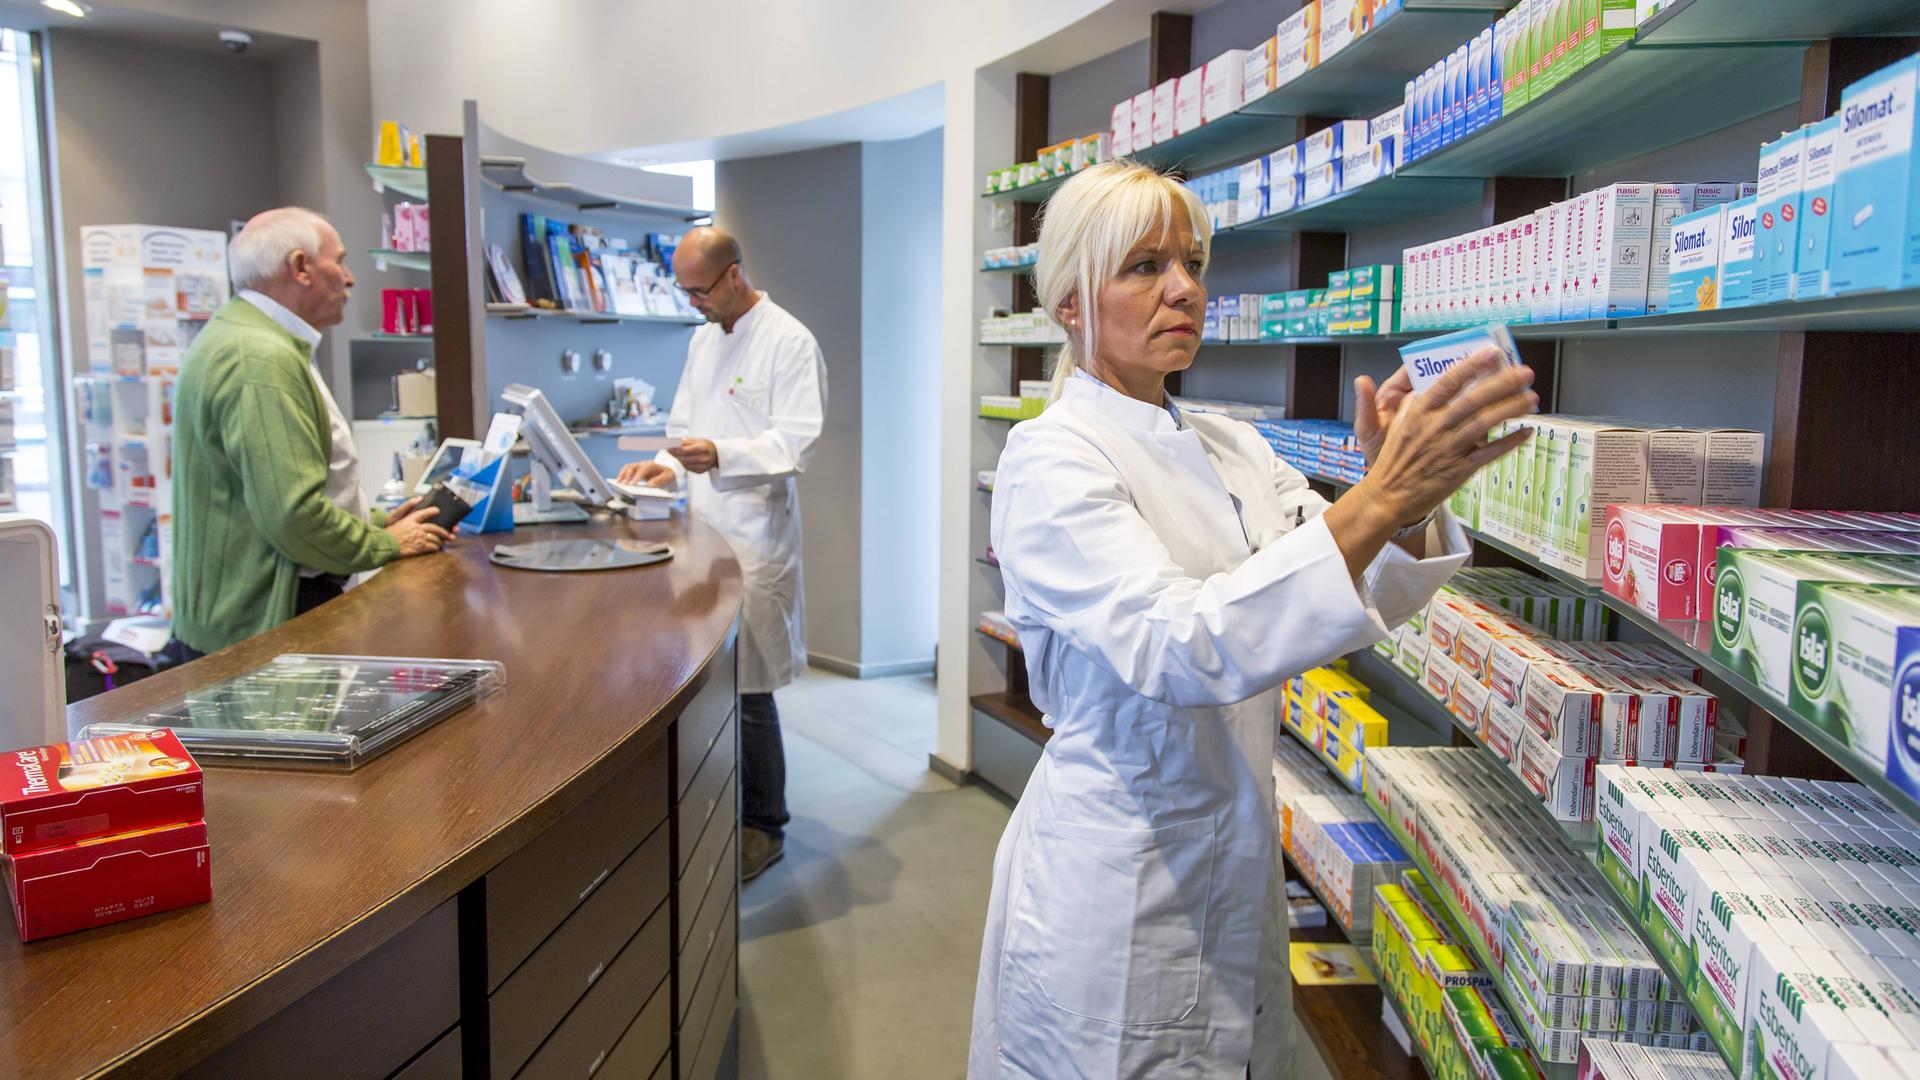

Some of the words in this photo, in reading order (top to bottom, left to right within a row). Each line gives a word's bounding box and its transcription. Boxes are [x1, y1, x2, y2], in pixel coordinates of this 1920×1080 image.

[1371, 112, 1400, 135] Voltaren
[1844, 92, 1894, 132] Silomat
[1344, 151, 1370, 170] Voltaren
[1779, 154, 1800, 170] Silomat
[1809, 144, 1833, 161] Silomat
[1760, 163, 1779, 180] Silomat
[1616, 187, 1640, 195] nasic
[1656, 187, 1680, 195] nasic
[1697, 187, 1721, 195] nasic
[1743, 187, 1757, 195] nas
[1674, 228, 1706, 253] Silomat
[1731, 216, 1755, 240] Silom
[1415, 352, 1467, 377] Silom
[1609, 534, 1623, 560] isla
[1675, 563, 1686, 581] isla
[1719, 587, 1741, 622] isla
[1799, 626, 1827, 669] isla
[1902, 684, 1920, 731] is
[1576, 717, 1585, 753] Dobendan
[1613, 719, 1621, 755] Dobendan
[1652, 721, 1662, 757] Dobendan
[1690, 722, 1699, 758] Dobendan
[16, 750, 50, 796] ThermaCare
[1569, 780, 1579, 817] Dobendan
[1599, 794, 1633, 849] Esberitox
[1611, 830, 1632, 857] COMPACT
[1647, 845, 1686, 910] Esberitox
[1659, 887, 1684, 921] COMPACT
[1696, 908, 1740, 986] Esberitox
[1445, 976, 1493, 987] PROSPAN
[1709, 957, 1736, 998] COMPACT
[1760, 989, 1815, 1080] Esberitox
